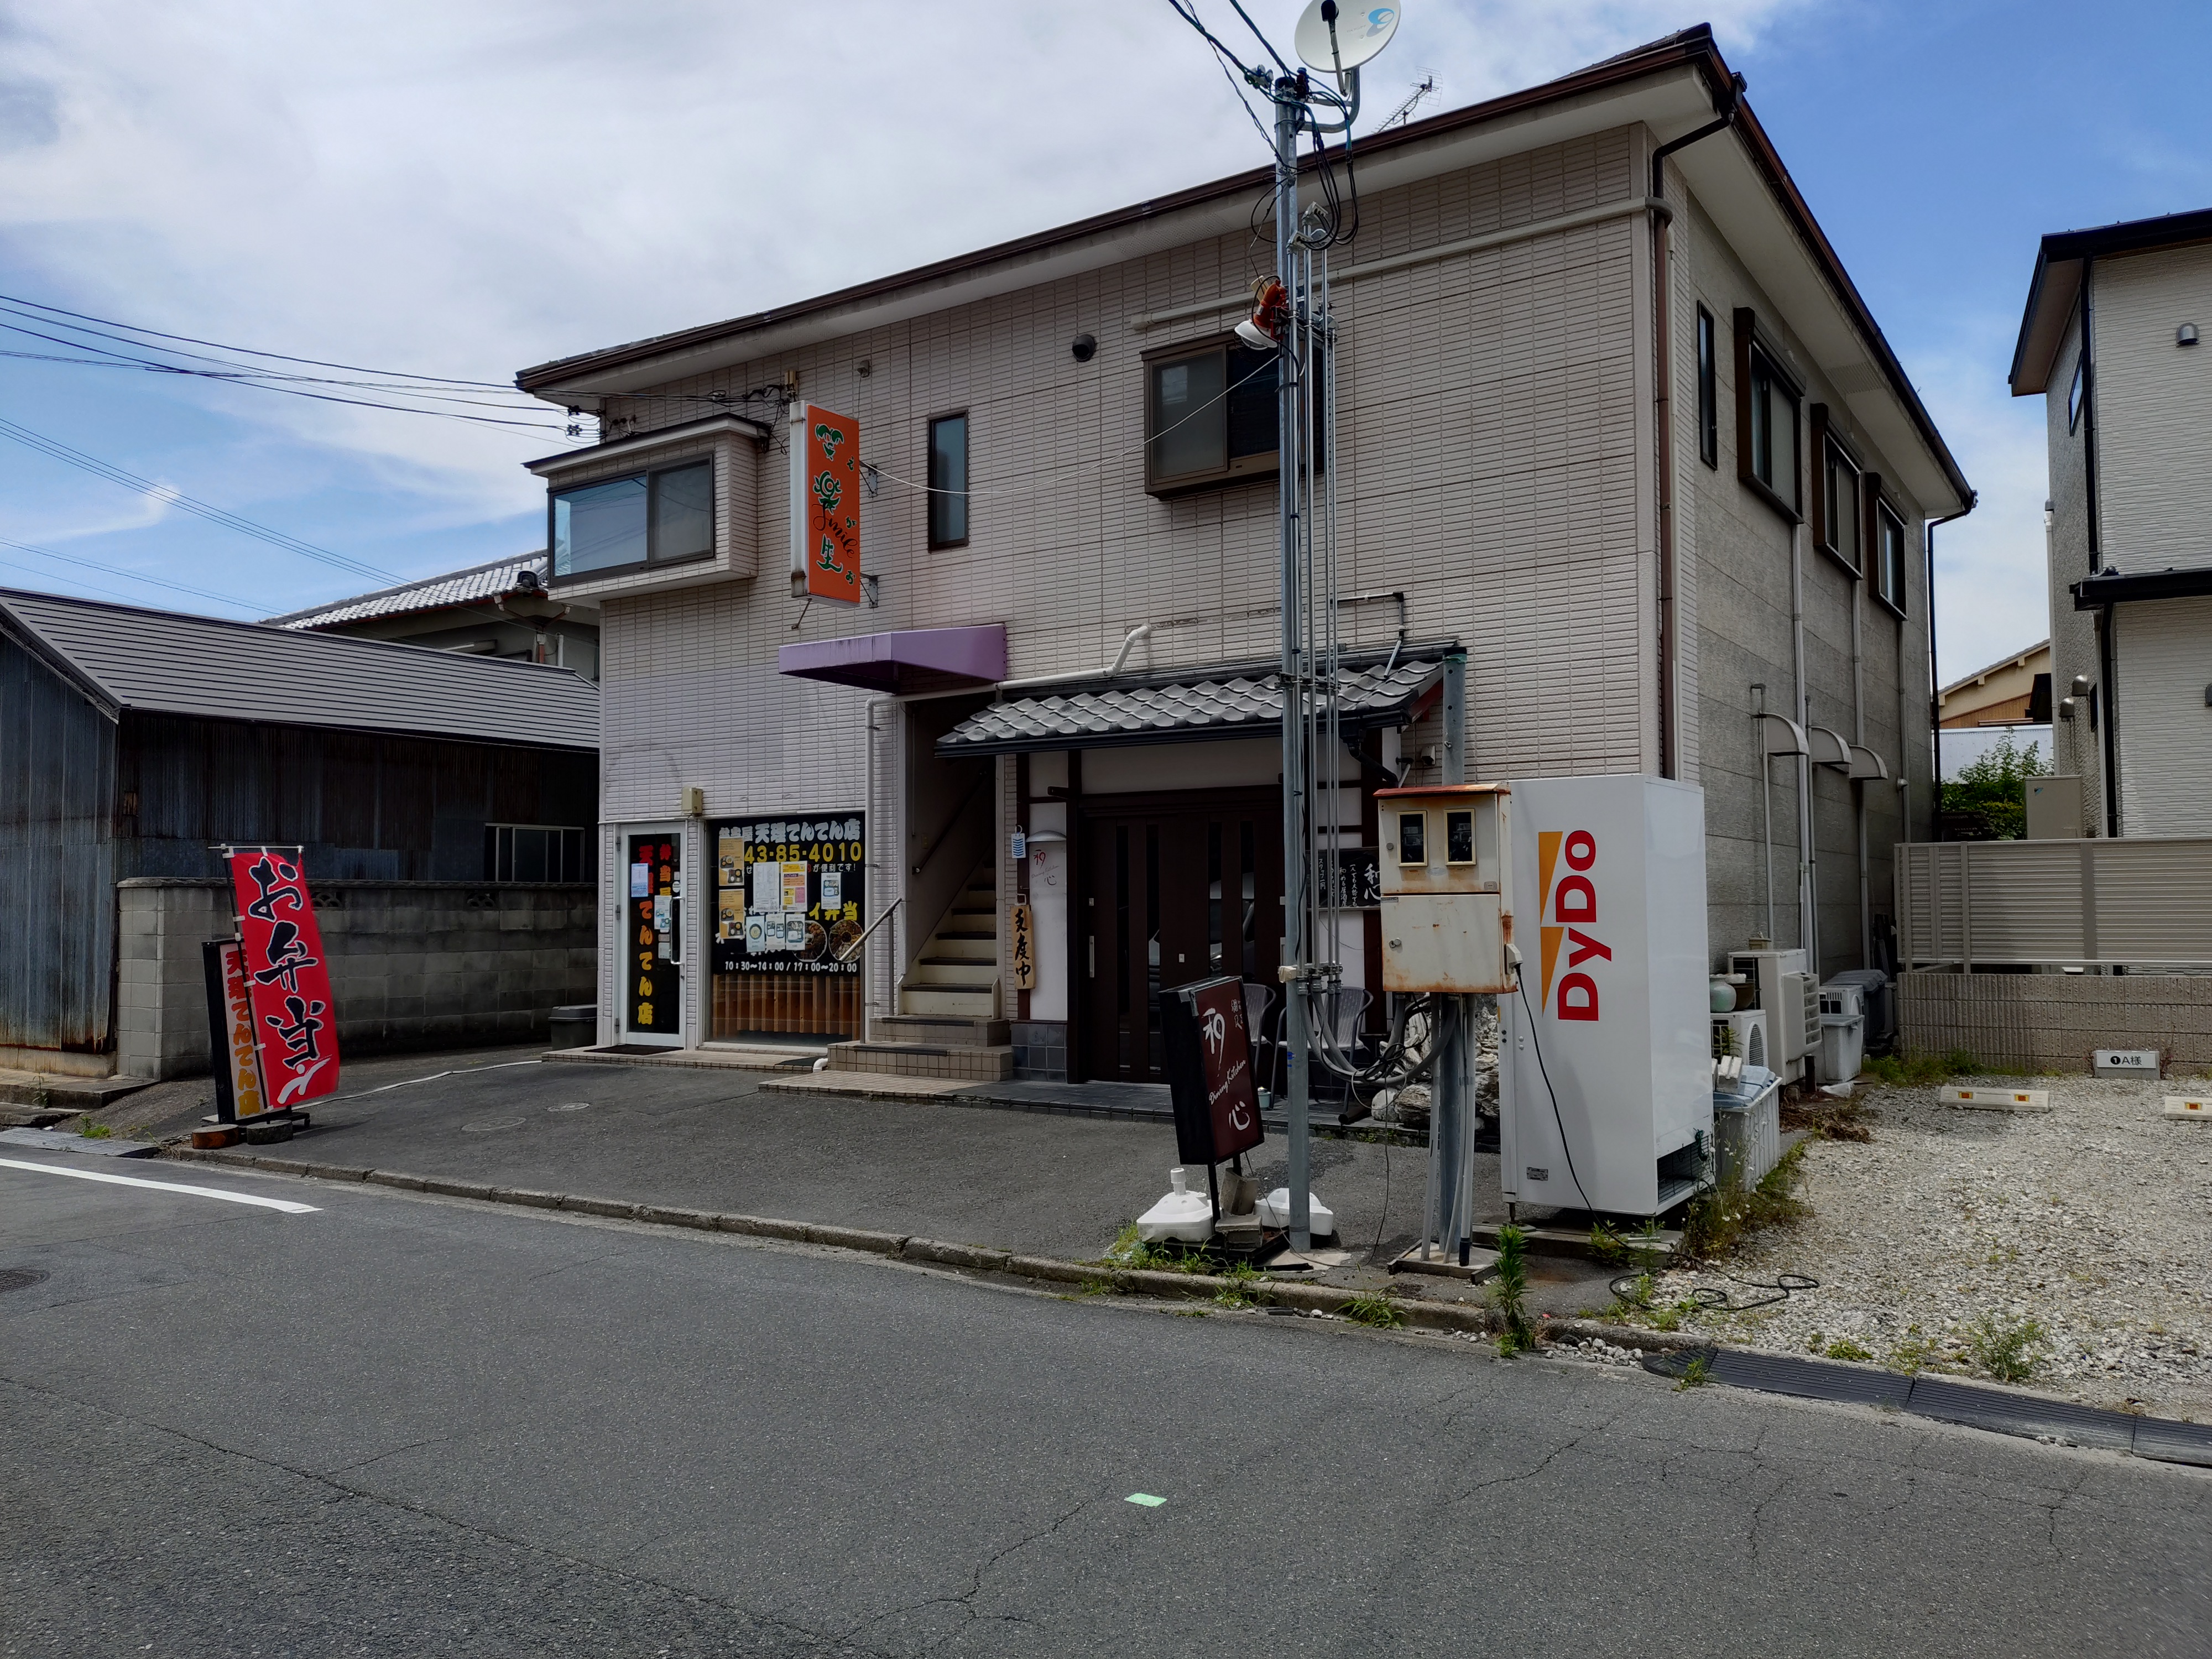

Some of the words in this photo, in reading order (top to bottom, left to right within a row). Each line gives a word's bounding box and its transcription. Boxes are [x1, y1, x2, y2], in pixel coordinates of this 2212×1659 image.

[248, 856, 325, 1070] お弁当
[1015, 909, 1031, 986] 支度中
[1554, 830, 1612, 1022] DyDo
[1209, 1081, 1228, 1105] Dining
[1227, 1060, 1246, 1084] Kitchen
